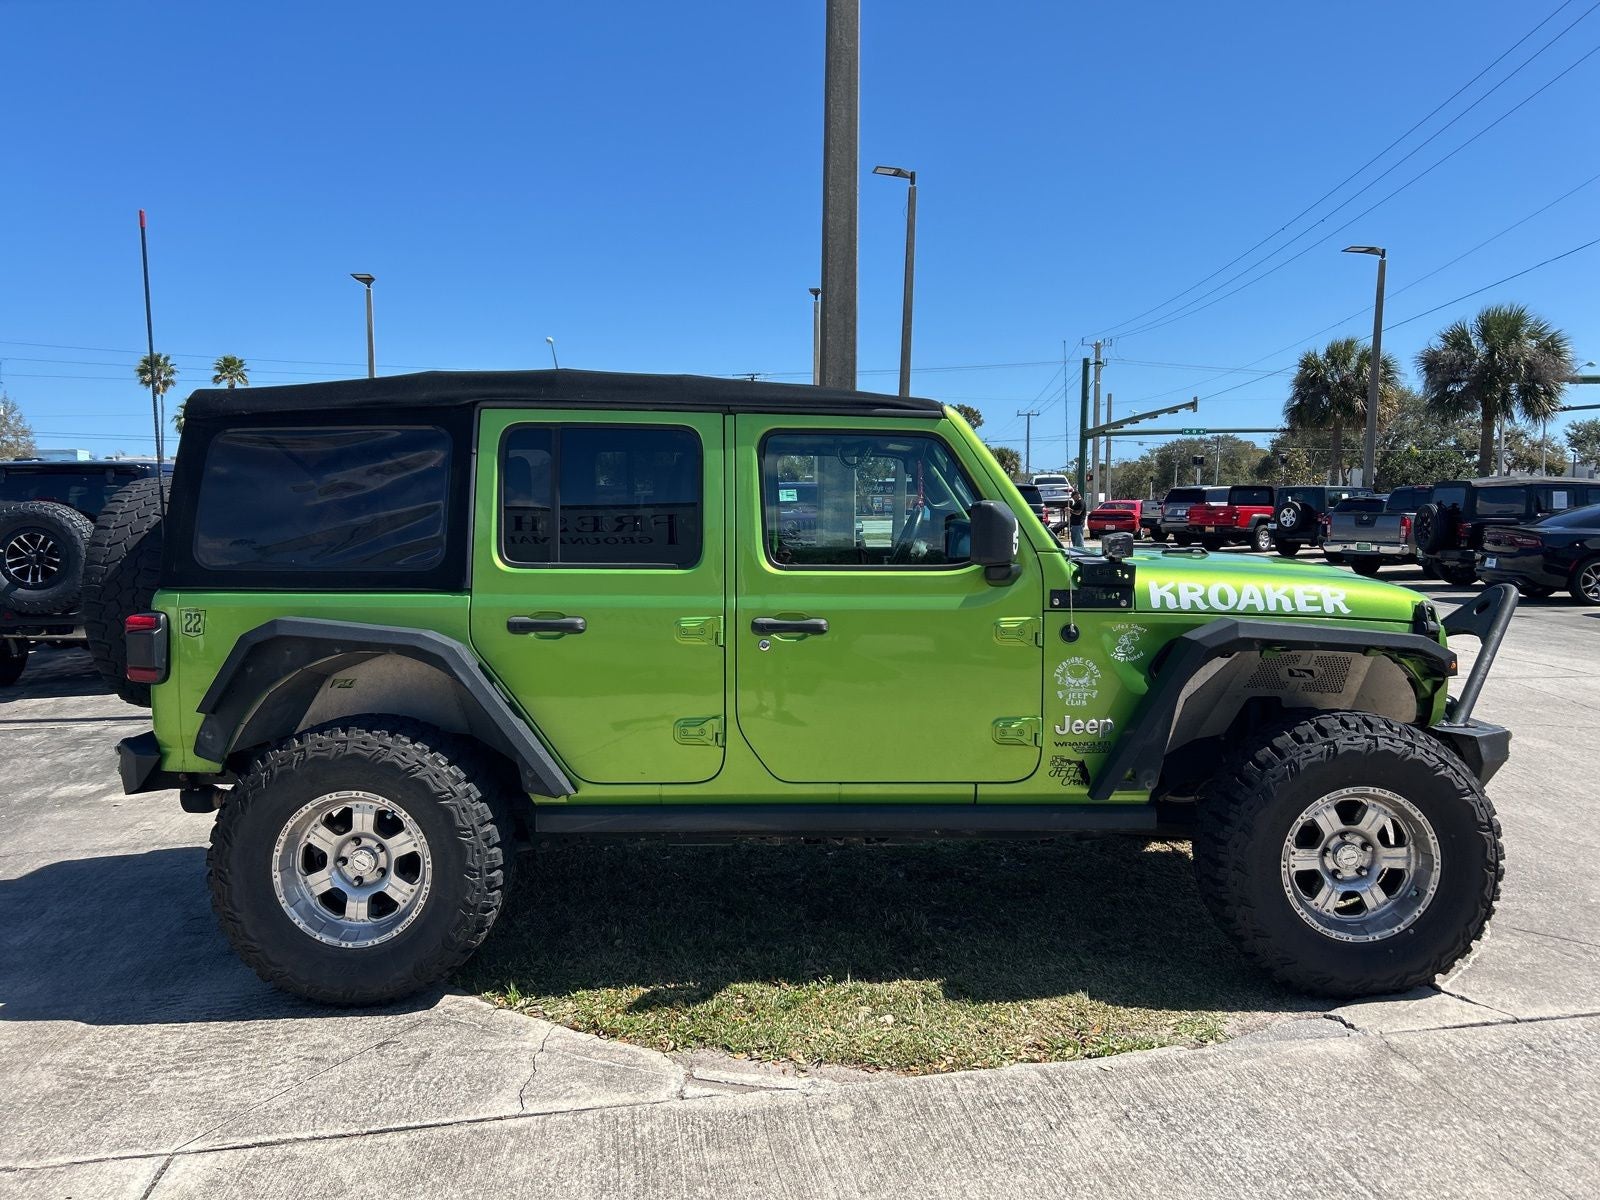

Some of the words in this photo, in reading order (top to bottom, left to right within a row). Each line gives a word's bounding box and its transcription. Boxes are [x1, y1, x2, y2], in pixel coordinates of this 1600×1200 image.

[1148, 581, 1352, 614] KROAKER
[185, 613, 201, 633] 22
[1131, 623, 1148, 633] Short
[1110, 651, 1125, 663] Jeep
[1053, 656, 1084, 678] TREASURE
[1085, 659, 1102, 679] COAST
[1068, 692, 1089, 700] JEEP
[1055, 715, 1115, 738] Jeep
